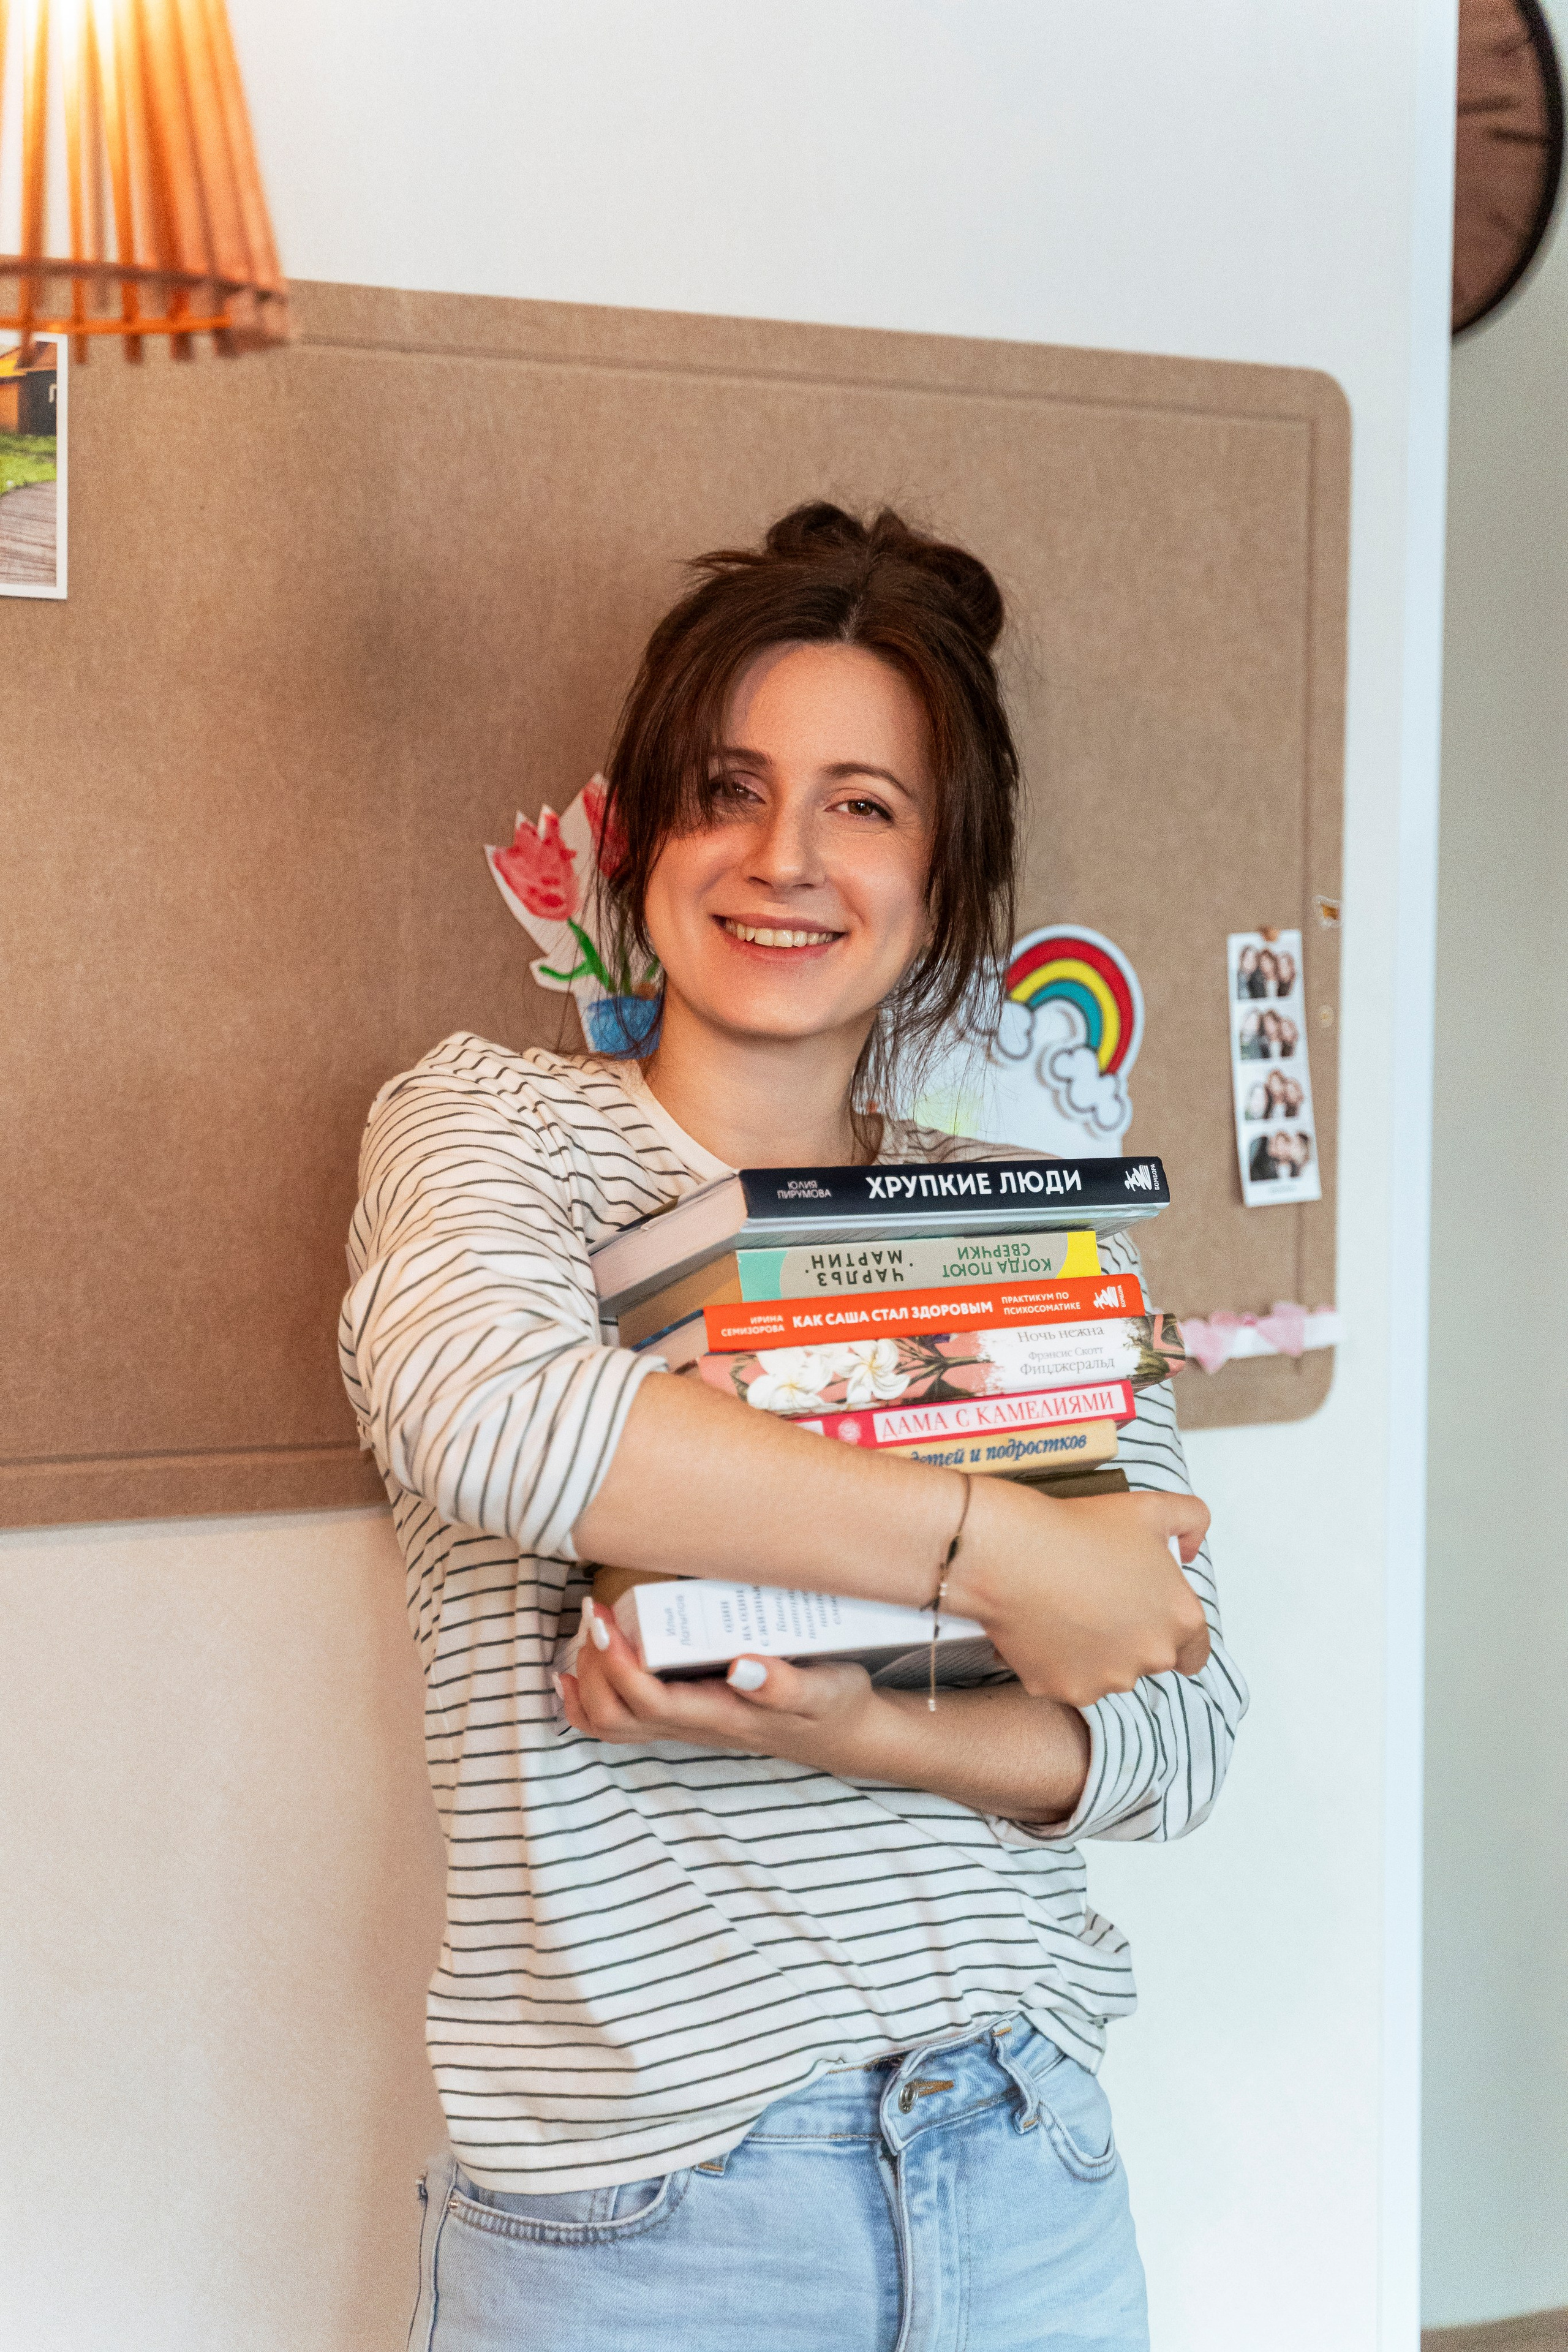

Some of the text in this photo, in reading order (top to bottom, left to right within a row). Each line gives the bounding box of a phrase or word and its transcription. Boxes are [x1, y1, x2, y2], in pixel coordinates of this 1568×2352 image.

[787, 1180, 818, 1189] ЮЛИЯ
[865, 1169, 1082, 1199] ХРУПКИЕ ЛЮДИ
[1150, 1163, 1160, 1191] БОМБОРА
[777, 1188, 832, 1199] ПИРУМОВА
[812, 1250, 903, 1270] МАРТИН
[957, 1243, 1031, 1261] СВЕРЧКИ
[942, 1257, 1052, 1278] КОГДА ПОЮТ
[818, 1268, 905, 1287] ЧАРЛЬЗ
[1001, 1291, 1069, 1305] ПРАКТИКУМ ПО
[1117, 1284, 1126, 1308] БОМБОРА
[792, 1301, 994, 1329] КАК САША СТАЛ ЗДОРОВЫМ
[1003, 1302, 1081, 1316] ПСИХОСОМАТИКЕ
[750, 1314, 784, 1325] ИРИНА
[720, 1324, 785, 1338] СЕМИЗОРОВА
[1017, 1327, 1105, 1343] Ночь нежна
[1028, 1347, 1104, 1363] Фрэнсис Скотт
[1020, 1358, 1115, 1375] Фицджеральд
[882, 1391, 1115, 1440] ДАМА С КАМЕЛИЯМИ
[970, 1449, 981, 1463] и
[986, 1434, 1088, 1461] подростков
